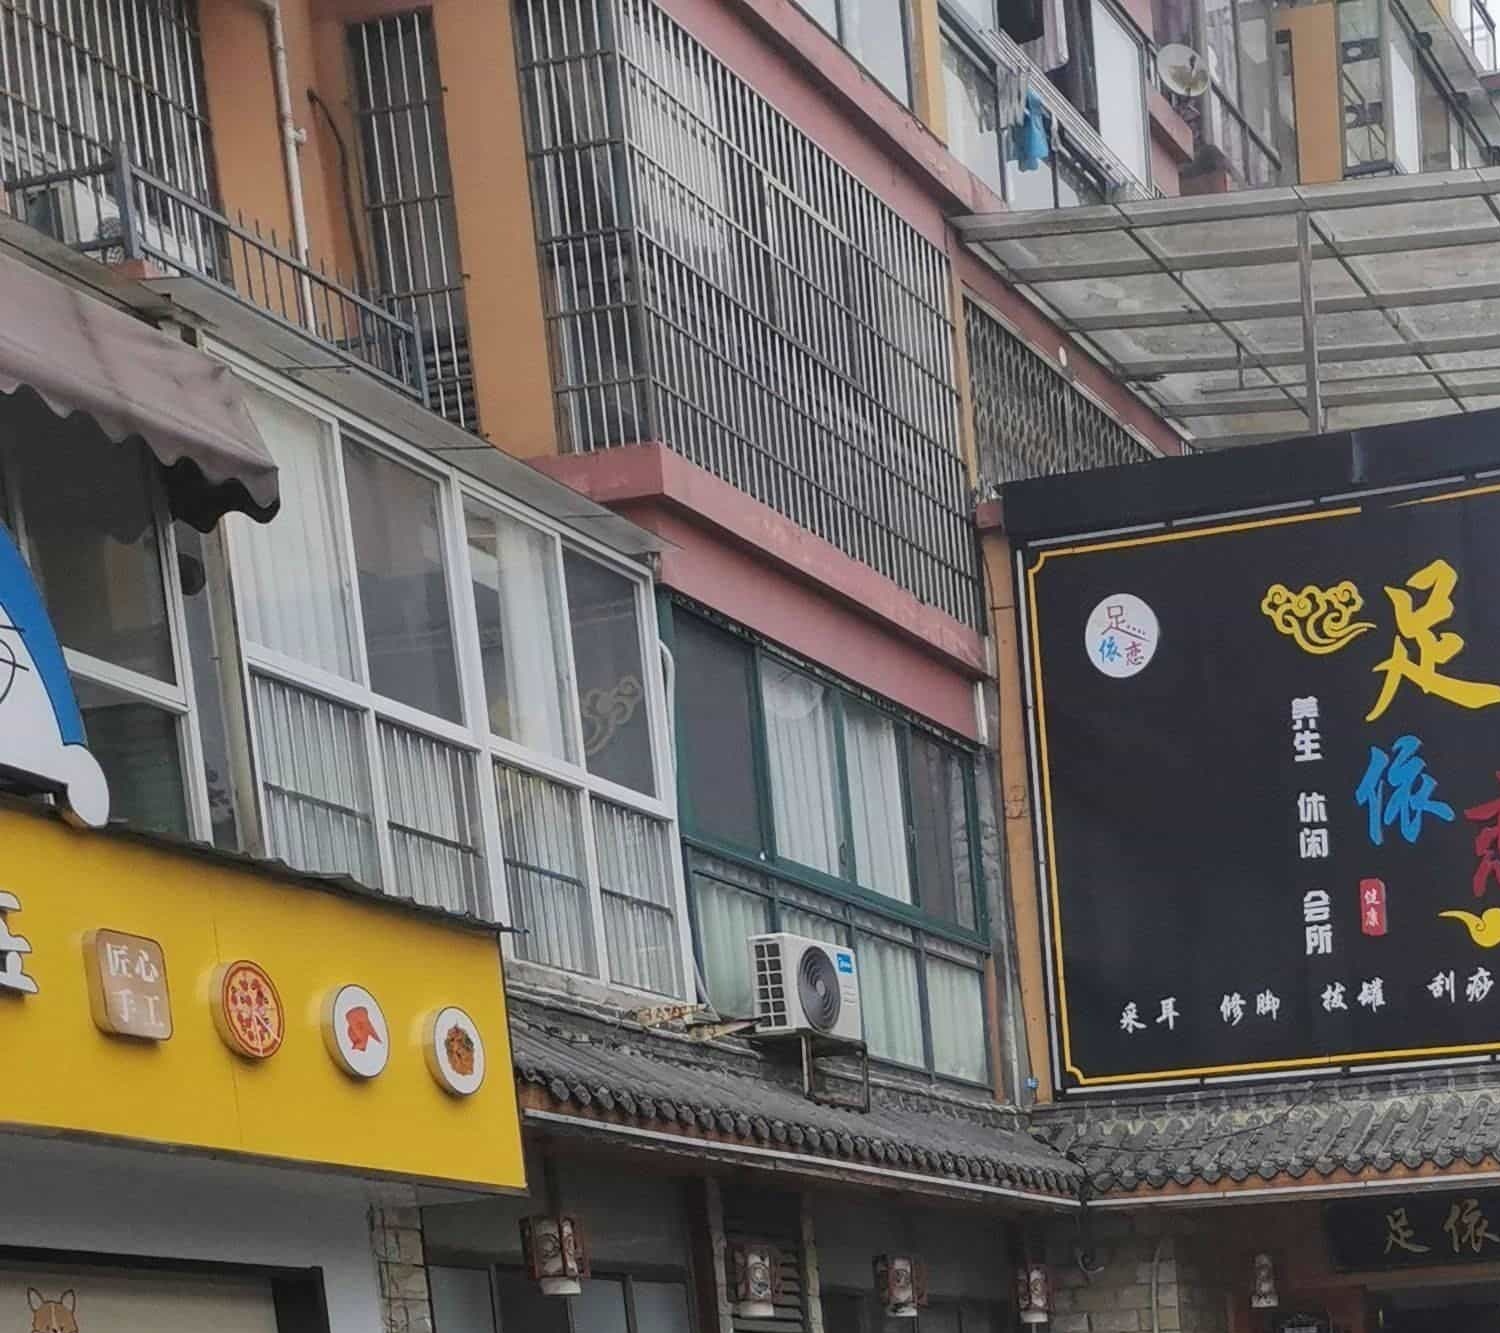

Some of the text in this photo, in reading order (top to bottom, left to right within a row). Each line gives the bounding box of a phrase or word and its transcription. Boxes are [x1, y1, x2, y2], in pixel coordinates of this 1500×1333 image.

[1291, 695, 1334, 955] 养生 休闲 会所
[105, 942, 160, 984] 匠心
[111, 988, 164, 1026] 手工
[1119, 996, 1181, 1034] 采耳
[1219, 989, 1281, 1027] 修脚
[1320, 979, 1386, 1013] 拔罐
[1426, 967, 1496, 1004] 刮痧
